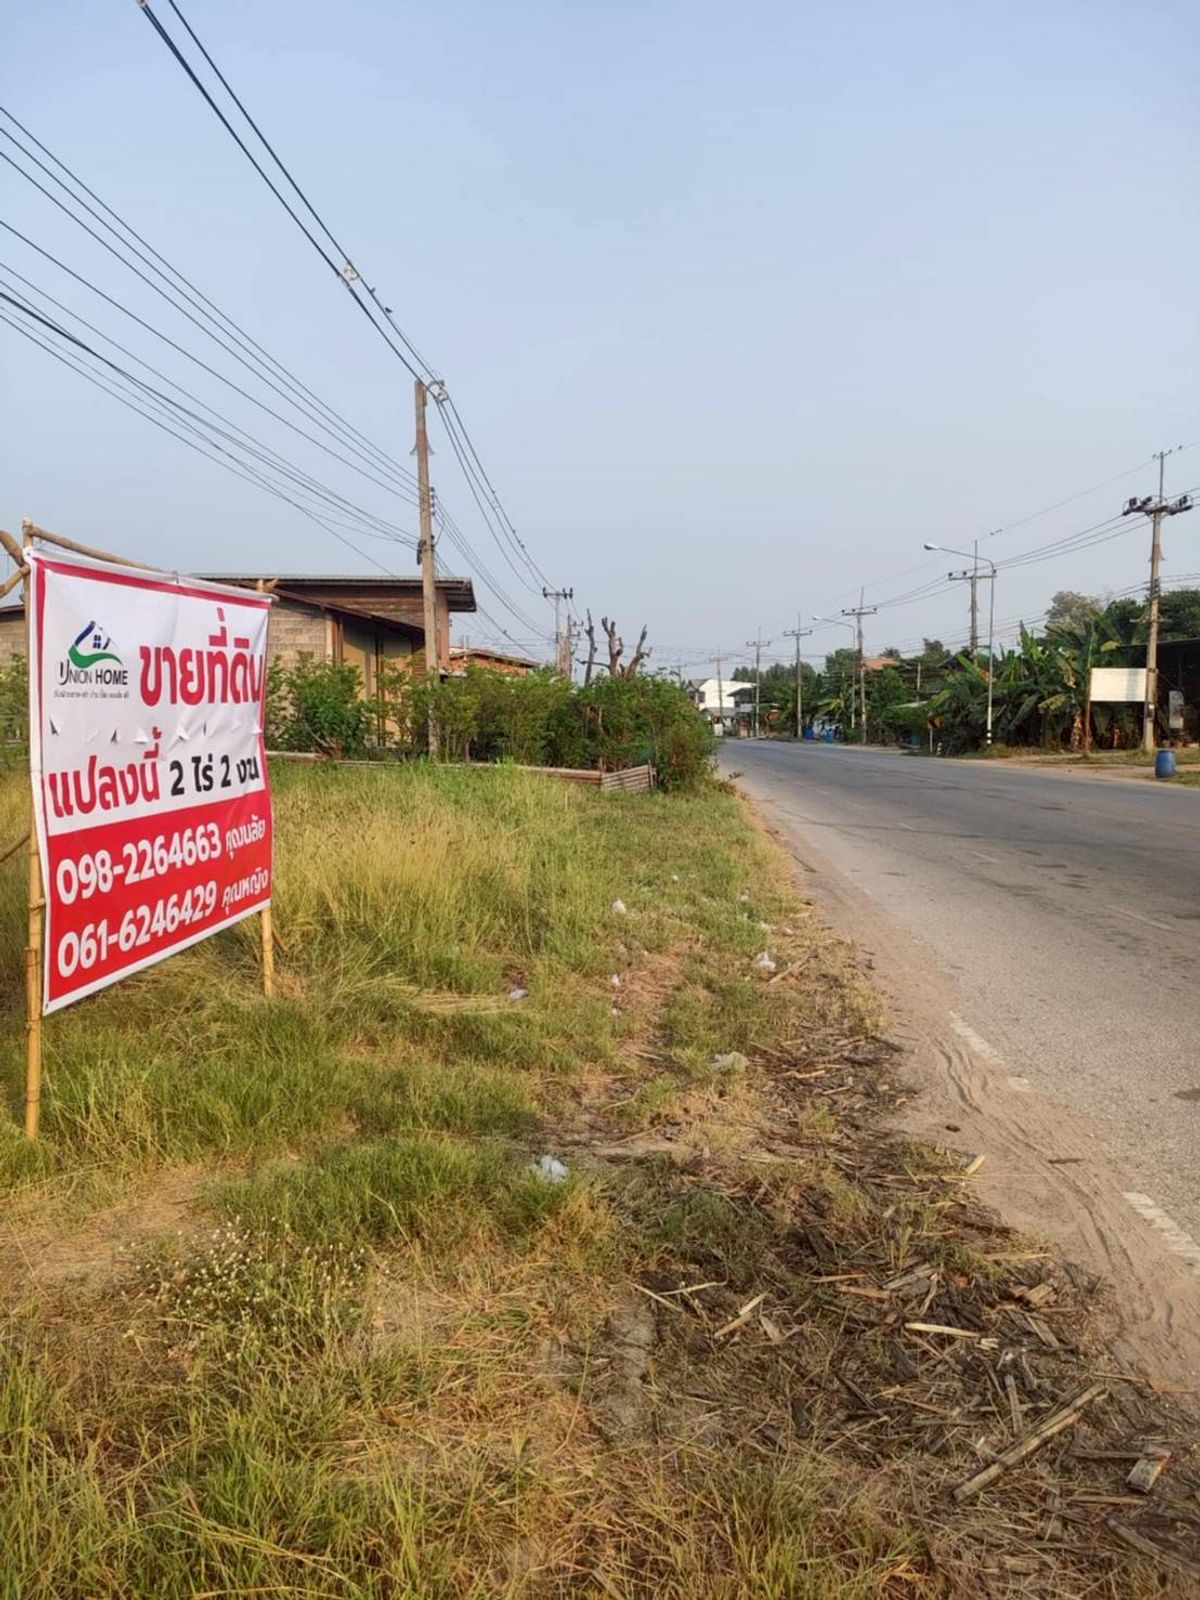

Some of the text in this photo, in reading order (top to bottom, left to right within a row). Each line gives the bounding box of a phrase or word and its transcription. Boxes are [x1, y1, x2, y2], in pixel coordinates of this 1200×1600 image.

[59, 659, 128, 685] UNION HOME
[139, 607, 262, 707] ขายที่ดิน
[49, 726, 162, 818] แปลงนี้
[170, 760, 185, 796] 2
[191, 753, 213, 792] ไร่
[221, 754, 231, 788] 2
[56, 822, 222, 906] 098-2264663
[57, 880, 217, 978] 061-6246429
